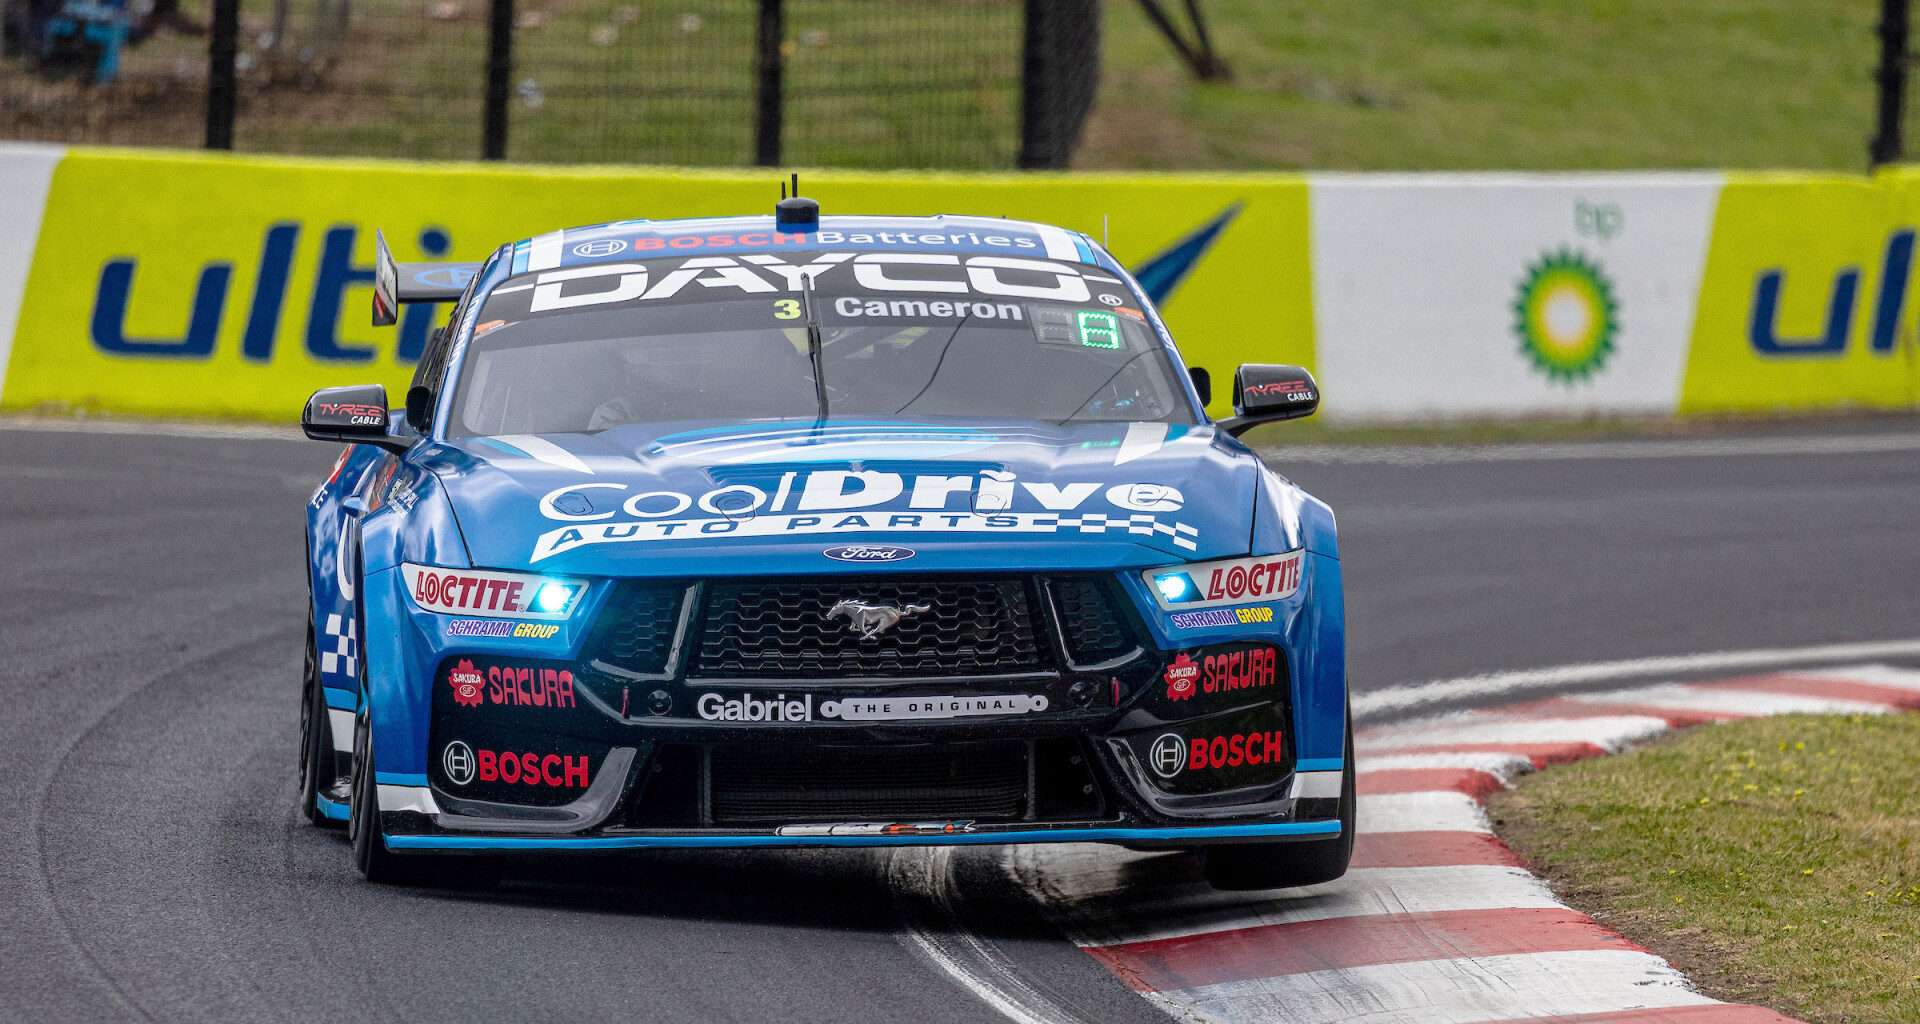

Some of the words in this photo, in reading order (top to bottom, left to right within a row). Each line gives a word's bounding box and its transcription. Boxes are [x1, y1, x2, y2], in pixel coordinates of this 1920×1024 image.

[1575, 200, 1625, 239] bp
[635, 232, 807, 251] BOSCH
[817, 232, 1036, 248] Batteries
[530, 253, 1091, 313] DAYCO
[1747, 226, 1920, 362] ul
[773, 299, 801, 320] 3
[836, 297, 1023, 321] Cameron
[1244, 381, 1309, 397] TYREE
[1287, 392, 1314, 402] CABLE
[320, 404, 386, 418] TYREE
[351, 416, 380, 425] CABLE
[550, 521, 732, 550] AUTO
[787, 514, 1019, 531] PARTS
[841, 546, 897, 560] Ford
[416, 571, 524, 612] LOCTITE
[1207, 557, 1299, 601] LOCTITE
[447, 619, 515, 637] SCHRAMM
[513, 623, 559, 638] GROUP
[1171, 609, 1238, 630] SCHRAMM
[1235, 607, 1274, 624] GROUP
[453, 673, 481, 684] SAKURA
[1169, 666, 1197, 679] SAKURA
[1203, 647, 1276, 694] SAKURA
[488, 666, 576, 708] SAKURA
[697, 693, 812, 722] Gabriel
[853, 704, 891, 714] THE
[908, 700, 1016, 712] ORIGINAL
[1189, 731, 1282, 769] BOSCH
[478, 749, 589, 787] BOSCH
